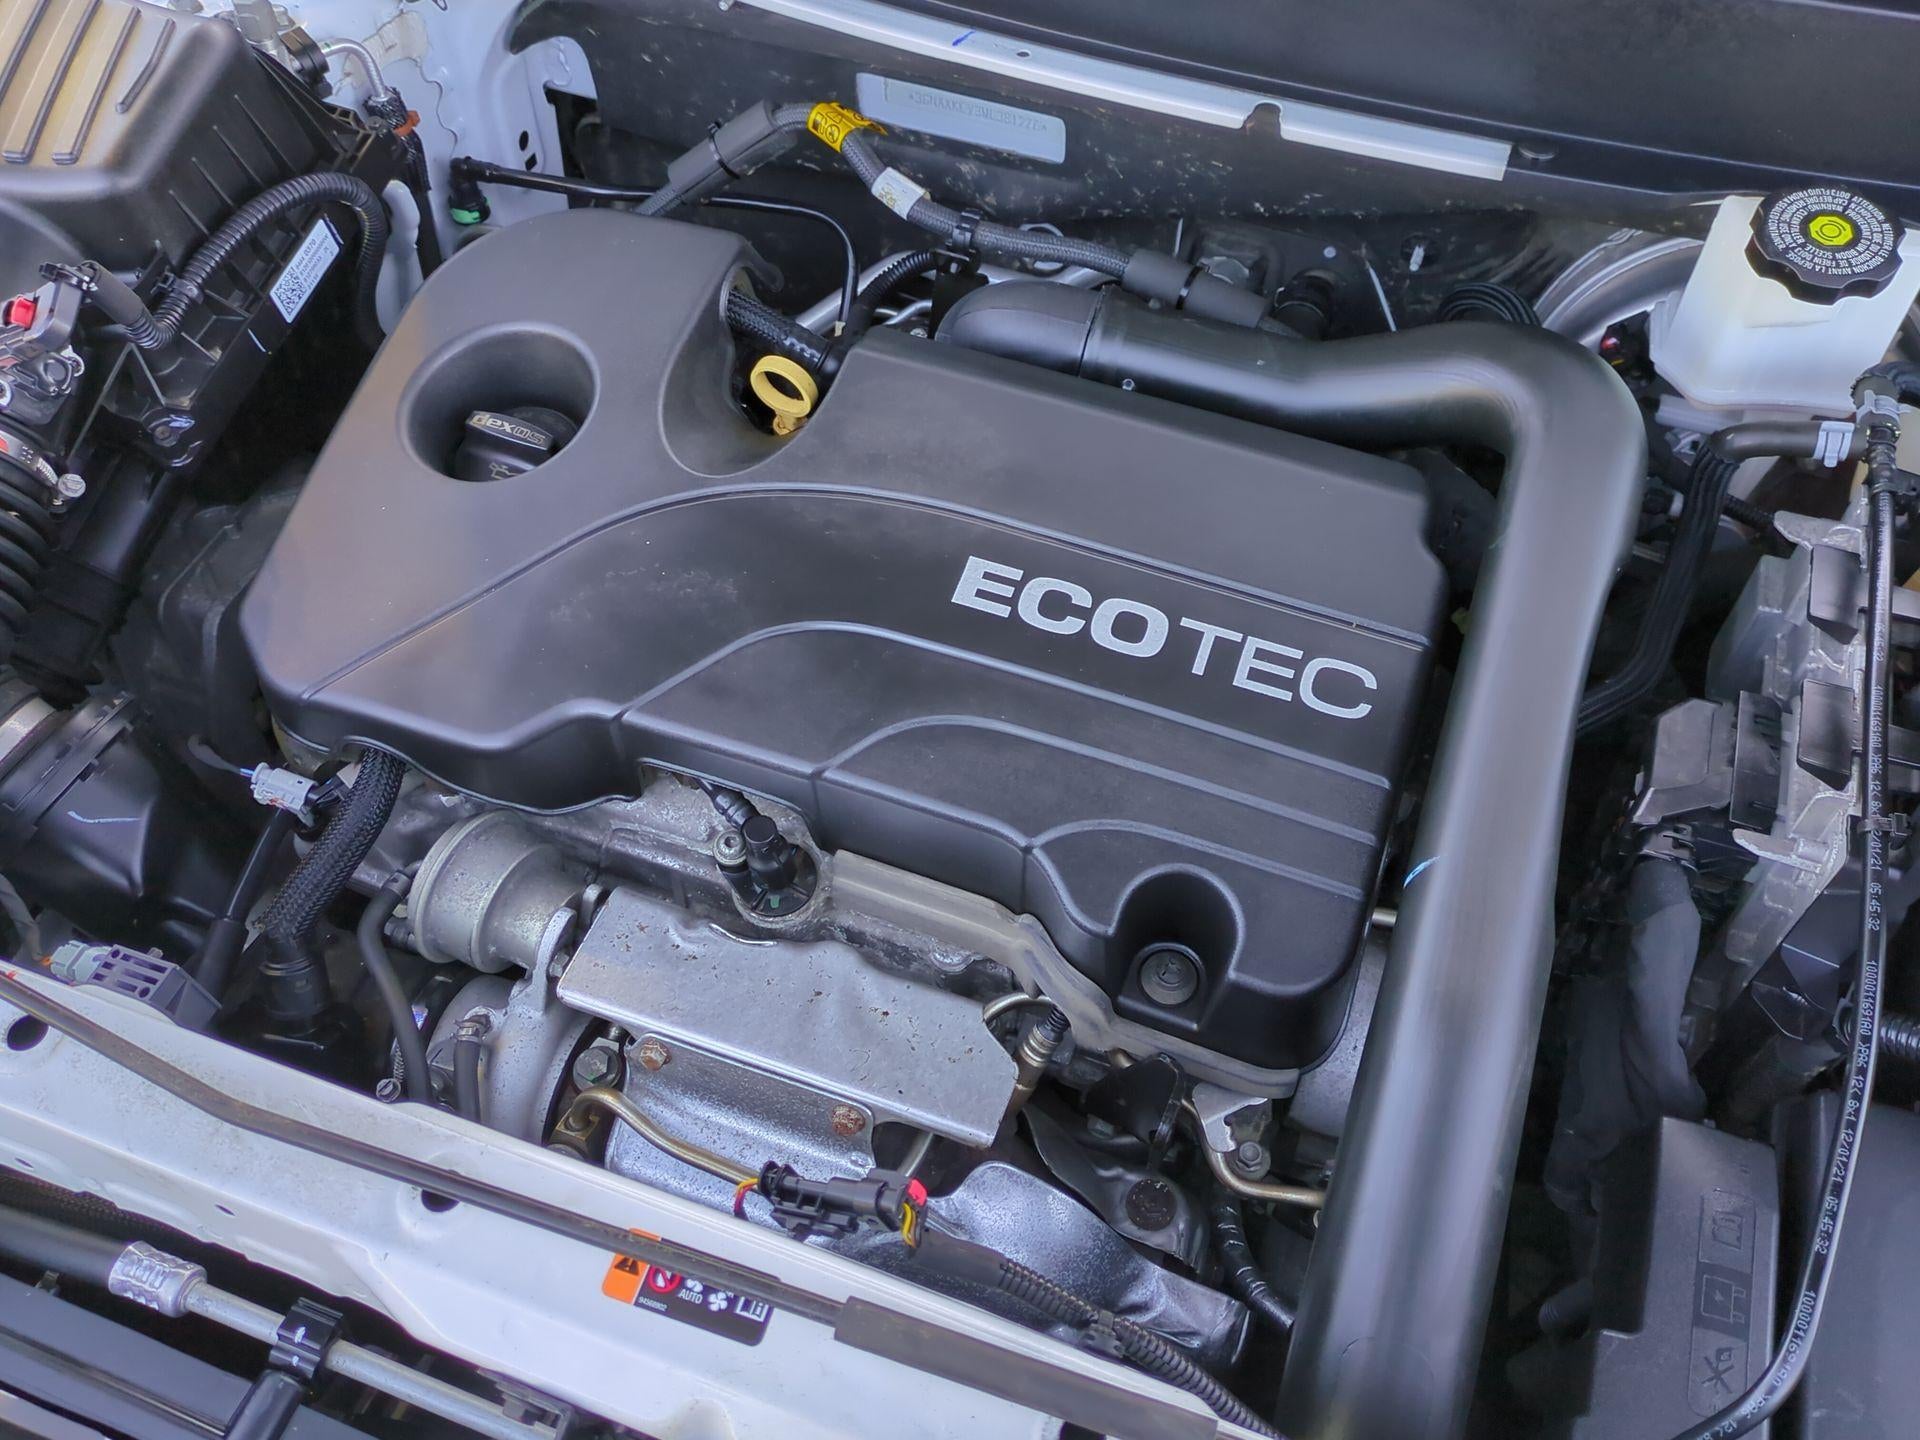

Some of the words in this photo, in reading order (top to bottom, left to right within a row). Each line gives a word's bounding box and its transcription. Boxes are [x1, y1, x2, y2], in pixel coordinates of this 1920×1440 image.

[1787, 190, 1808, 202] FROM
[1808, 188, 1830, 196] FLUID
[1830, 189, 1851, 199] DOT3
[1804, 195, 1832, 204] BEFORE
[1833, 197, 1848, 206] CAP
[1769, 201, 1788, 220] SEALED
[1779, 223, 1789, 233] USE
[1844, 209, 1871, 239] PROVENANT
[1781, 233, 1797, 247] ONLY
[1872, 232, 1882, 243] QUE
[1881, 223, 1894, 250] NETTOYER
[1794, 247, 1813, 260] DOT3
[1835, 249, 1858, 259] BIDON
[1869, 243, 1881, 252] DU
[1878, 249, 1890, 258] LE
[1812, 256, 1836, 267] FREIN
[1838, 259, 1848, 267] DE
[1849, 250, 1875, 266] LIQUIDE
[1852, 255, 1884, 273] BOUCHON
[1815, 264, 1826, 272] LA
[1828, 267, 1851, 275] AVANT
[472, 414, 546, 444] dexos
[951, 555, 1378, 720] ECOTEC
[1868, 882, 1882, 931] 05:45:32
[1859, 960, 1878, 1037] 1000011691A0
[1845, 1098, 1859, 1121] 8x1
[1831, 1128, 1854, 1184] 12/01/21
[1815, 1195, 1840, 1255] 05:45:32
[678, 1288, 703, 1304] AUTO
